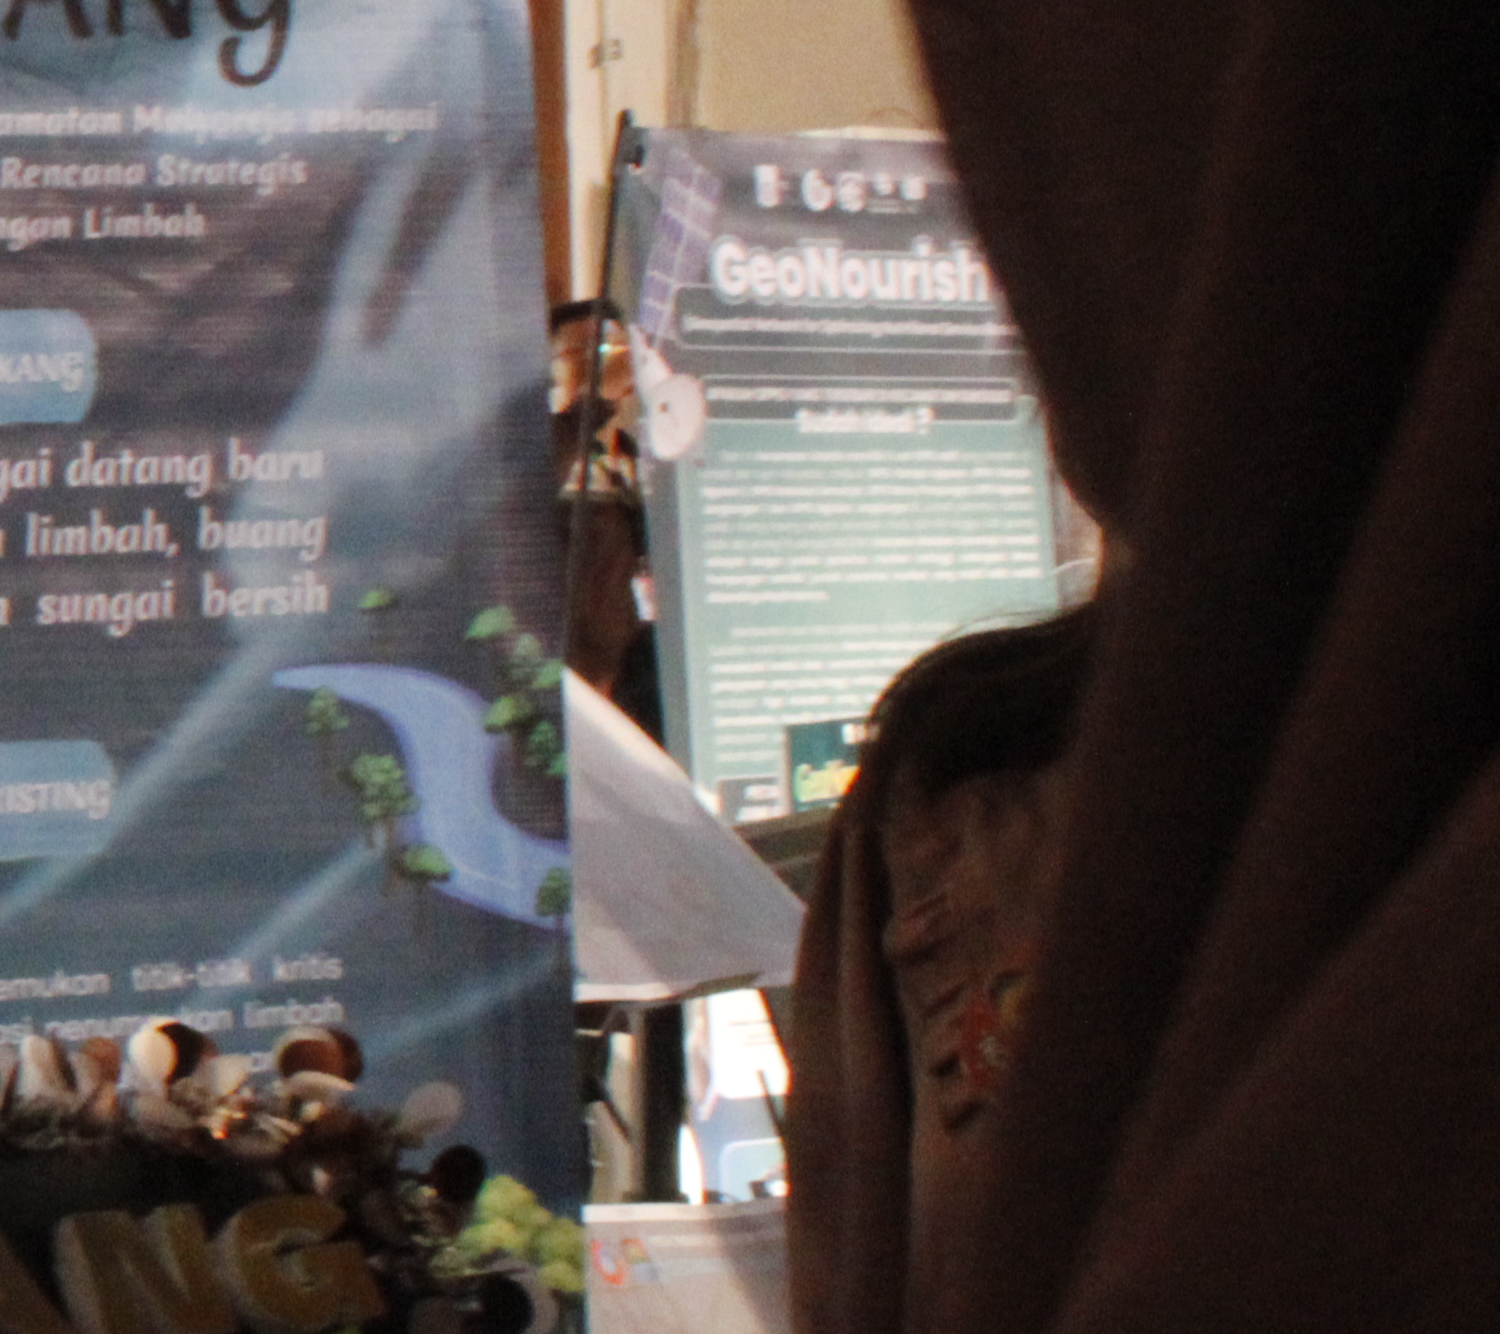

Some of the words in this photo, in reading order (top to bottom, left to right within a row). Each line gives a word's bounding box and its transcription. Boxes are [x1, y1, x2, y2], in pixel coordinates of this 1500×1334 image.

[0, 155, 148, 189] Rencana
[156, 152, 309, 195] Strategis
[82, 201, 206, 240] Limbah
[710, 237, 990, 303] GeoNourish
[66, 447, 216, 497] datang
[228, 441, 324, 484] baru
[26, 513, 180, 560] limbah,
[198, 510, 328, 560] buang
[36, 582, 174, 632] sungai
[202, 575, 330, 618] bersih
[243, 996, 346, 1030] limbah
